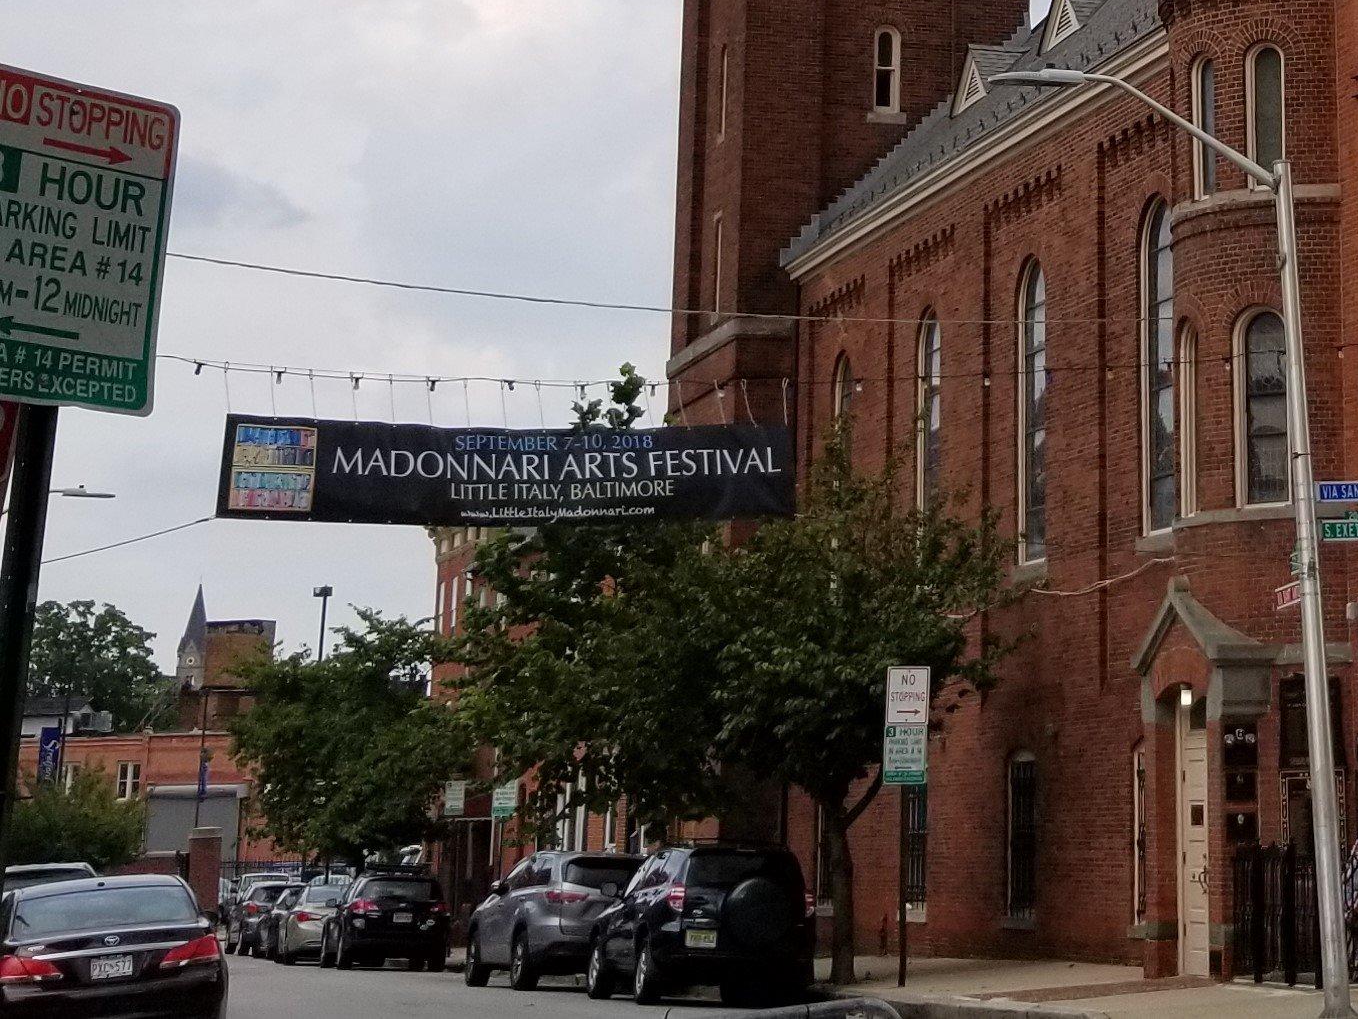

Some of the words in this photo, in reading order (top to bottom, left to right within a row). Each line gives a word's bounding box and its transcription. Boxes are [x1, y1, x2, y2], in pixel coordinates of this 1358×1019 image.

[36, 91, 165, 151] STOPPING
[38, 162, 146, 217] HOUR
[92, 216, 151, 253] LIMIT
[5, 238, 87, 277] AREA
[63, 290, 143, 327] MIDNIGHT
[58, 351, 138, 380] PERMIT
[38, 373, 137, 403] EXCEPTED
[455, 435, 557, 451] SEPTEMBER
[564, 434, 607, 450] 7-10,
[612, 435, 653, 449] 2018
[332, 446, 549, 480] MADONNARI
[559, 451, 638, 480] ARTS
[648, 446, 782, 476] FESTIVAL
[451, 482, 508, 500] LITTLE
[514, 482, 564, 502] ITALY,
[570, 480, 675, 499] BALTIMORE
[1322, 485, 1339, 499] VIA
[901, 674, 916, 686] NO
[890, 691, 926, 702] STOPPING
